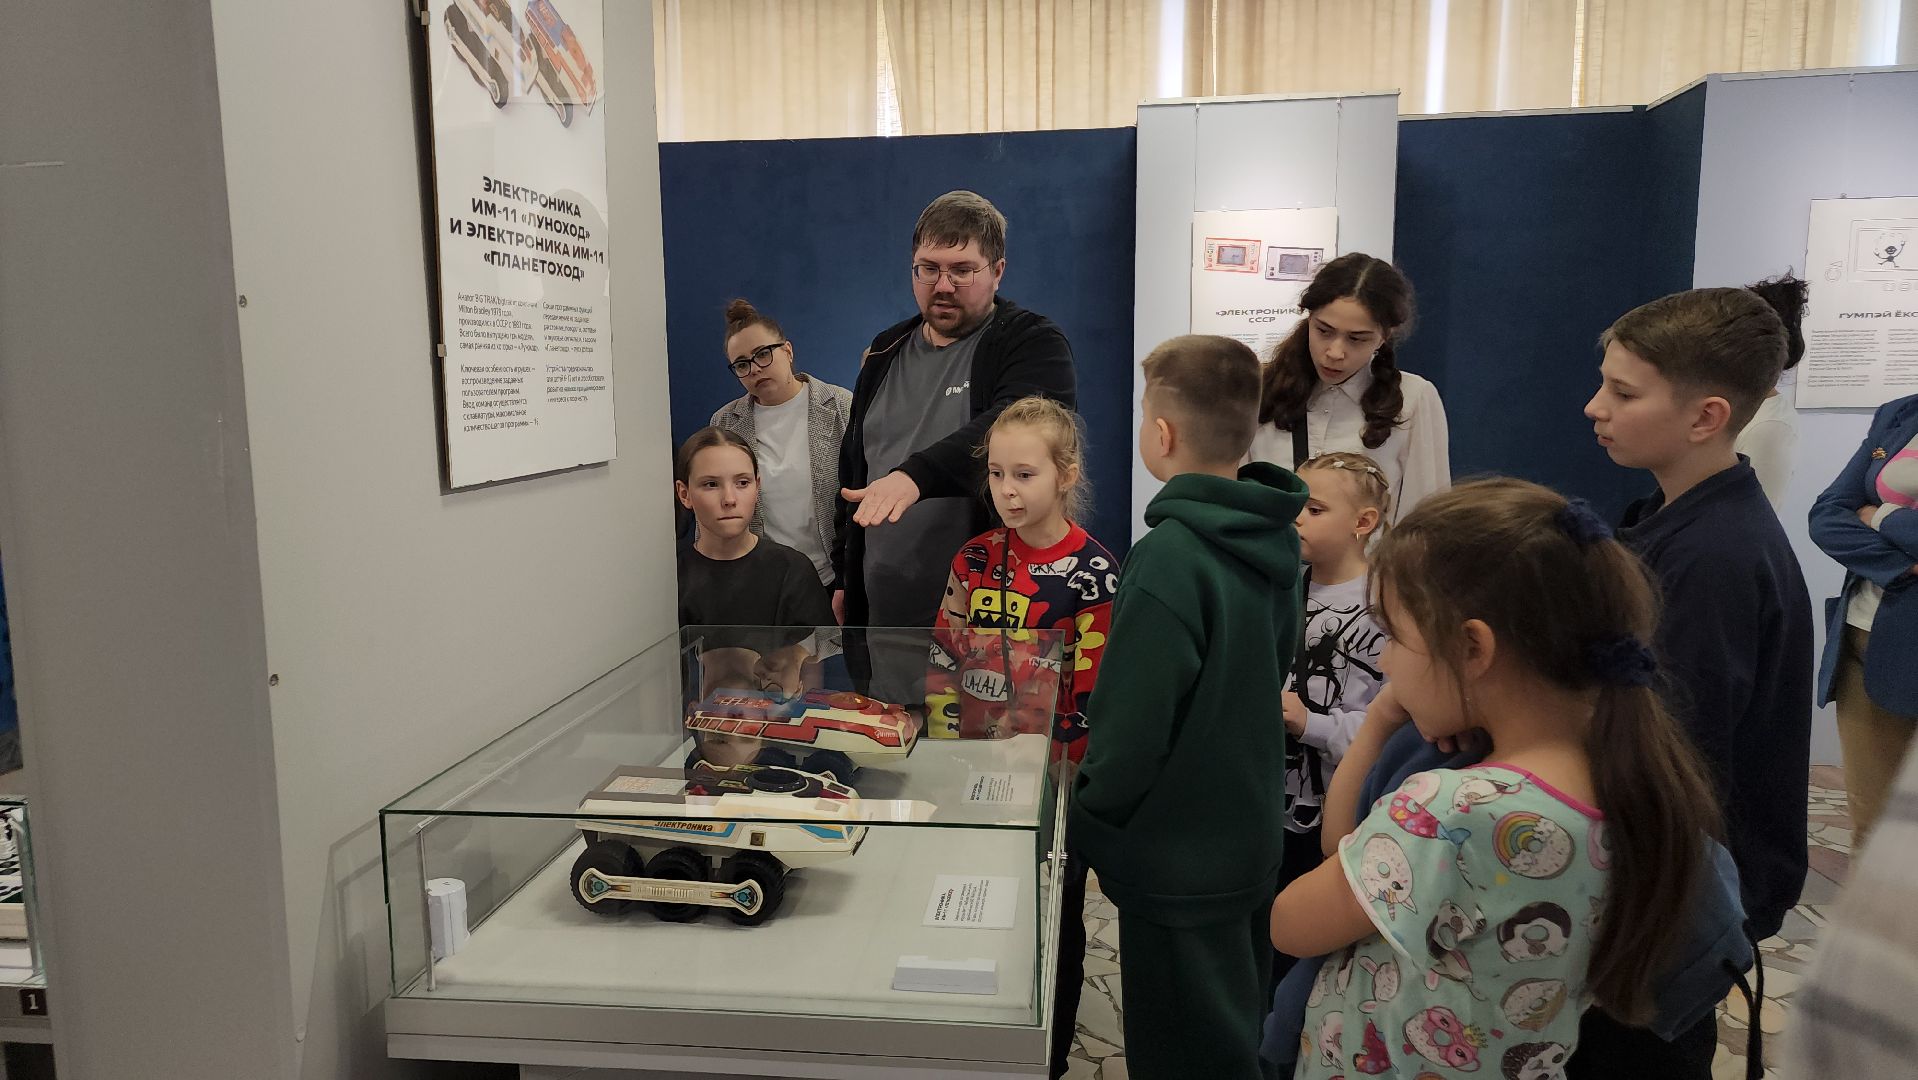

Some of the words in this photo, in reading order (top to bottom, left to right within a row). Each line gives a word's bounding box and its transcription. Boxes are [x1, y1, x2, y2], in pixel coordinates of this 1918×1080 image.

[483, 176, 581, 218] ЭЛЕКТРОНИКА
[471, 198, 517, 223] ИМ-11
[521, 212, 591, 243] «ЛУНОХОД»
[450, 217, 462, 235] И
[466, 221, 570, 257] ЭЛЕКТРОНИКА
[572, 244, 605, 264] ИМ-11
[483, 250, 585, 282] «ПЛАНЕТОХОД»
[1839, 310, 1892, 319] ГУМПЭЙ
[28, 993, 39, 1010] 1
